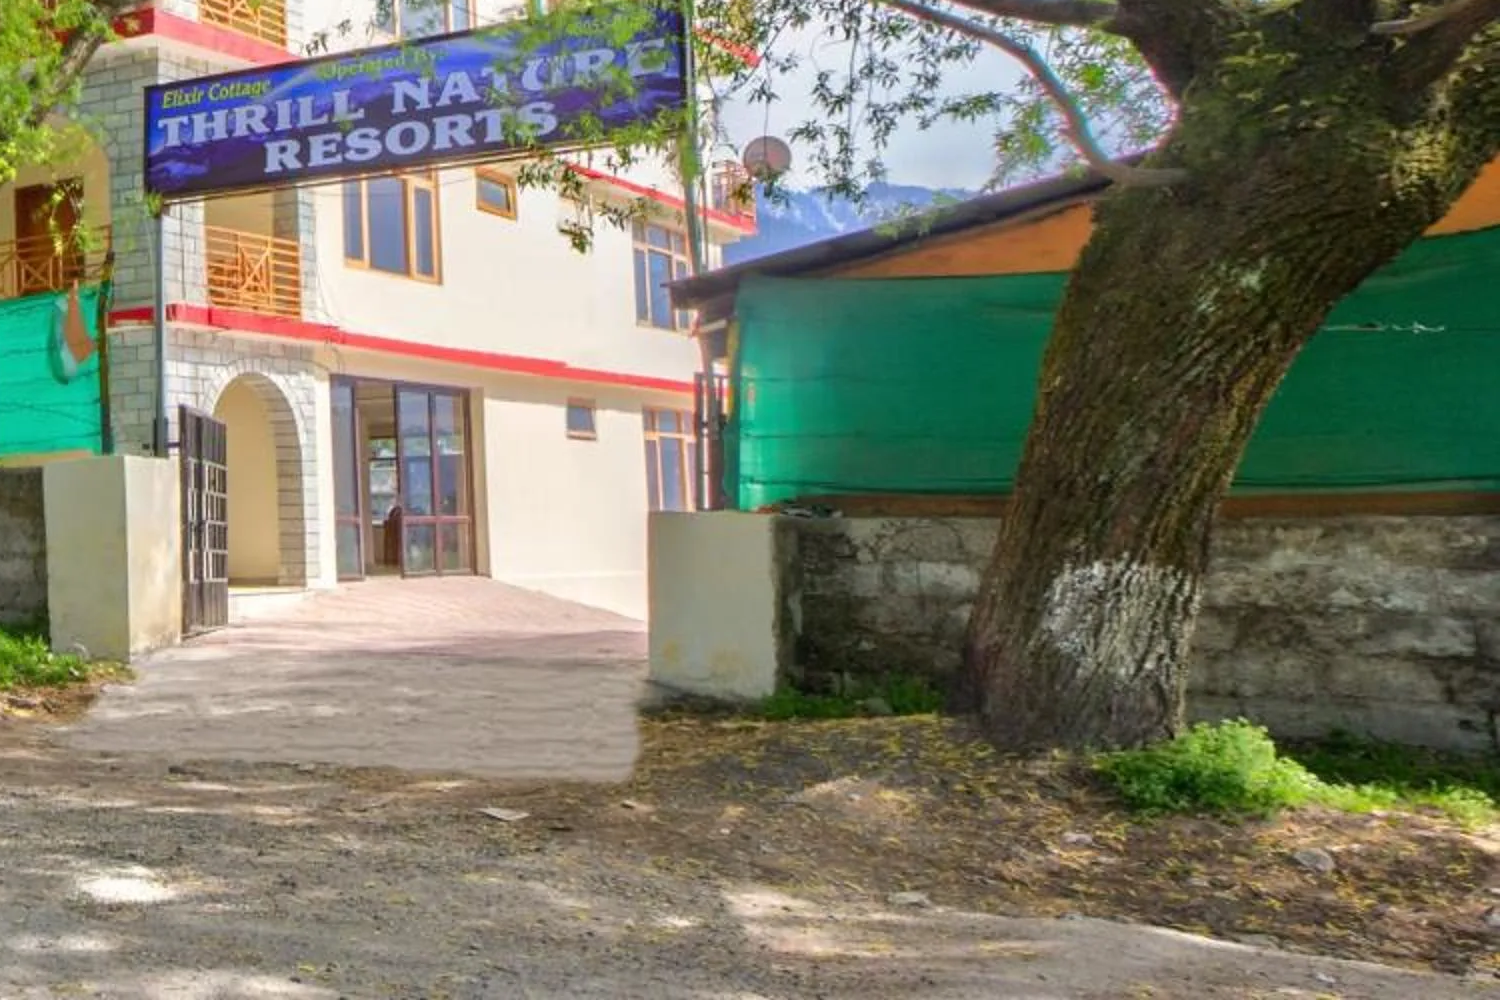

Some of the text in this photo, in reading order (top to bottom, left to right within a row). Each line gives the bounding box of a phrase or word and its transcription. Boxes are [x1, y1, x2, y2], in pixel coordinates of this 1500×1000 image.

[158, 38, 667, 147] THRILL NATURE
[163, 79, 272, 109] Elixir Cottage
[264, 101, 558, 174] RESORTS
